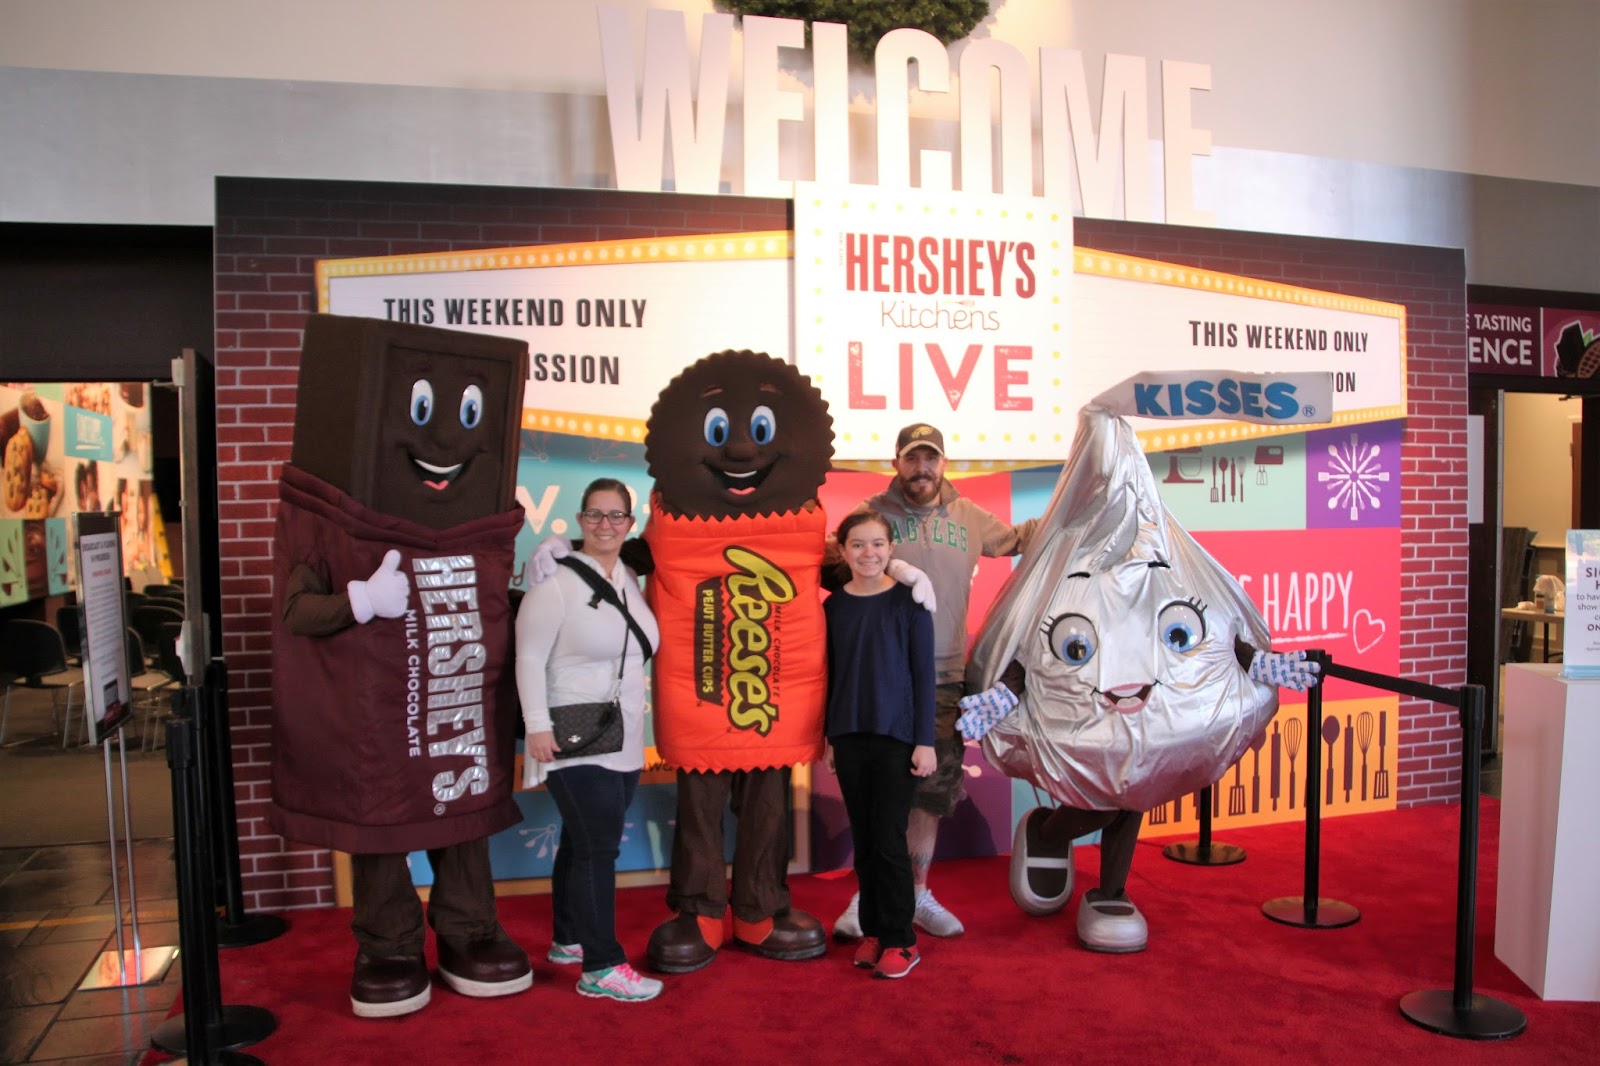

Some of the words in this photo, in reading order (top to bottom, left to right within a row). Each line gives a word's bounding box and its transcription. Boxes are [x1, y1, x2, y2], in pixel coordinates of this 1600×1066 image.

[598, 7, 1212, 226] WELCOME
[846, 233, 1036, 299] HERSHEY'S
[384, 298, 434, 324] THIS
[444, 298, 564, 326] WEEKEND
[576, 299, 647, 328] ONLY
[881, 300, 1001, 331] Kitchens
[1474, 314, 1532, 333] TASTING
[1188, 320, 1238, 348] THIS
[1246, 324, 1328, 351] WEEKEND
[1333, 330, 1368, 352] ONLY
[1468, 336, 1532, 365] ENCE
[848, 341, 1034, 411] LIVE
[1134, 378, 1300, 420] KISSES
[892, 516, 967, 552] AGLES
[773, 604, 783, 632] MILK
[1263, 571, 1353, 631] HAPPY
[404, 608, 419, 650] MILK
[702, 623, 715, 663] BUTTER
[724, 546, 797, 736] Reese's
[412, 554, 490, 803] HERSHEY'S
[702, 665, 714, 694] CUPS
[772, 637, 783, 698] CHOCOLATE
[406, 655, 421, 758] CHOCOLATE
